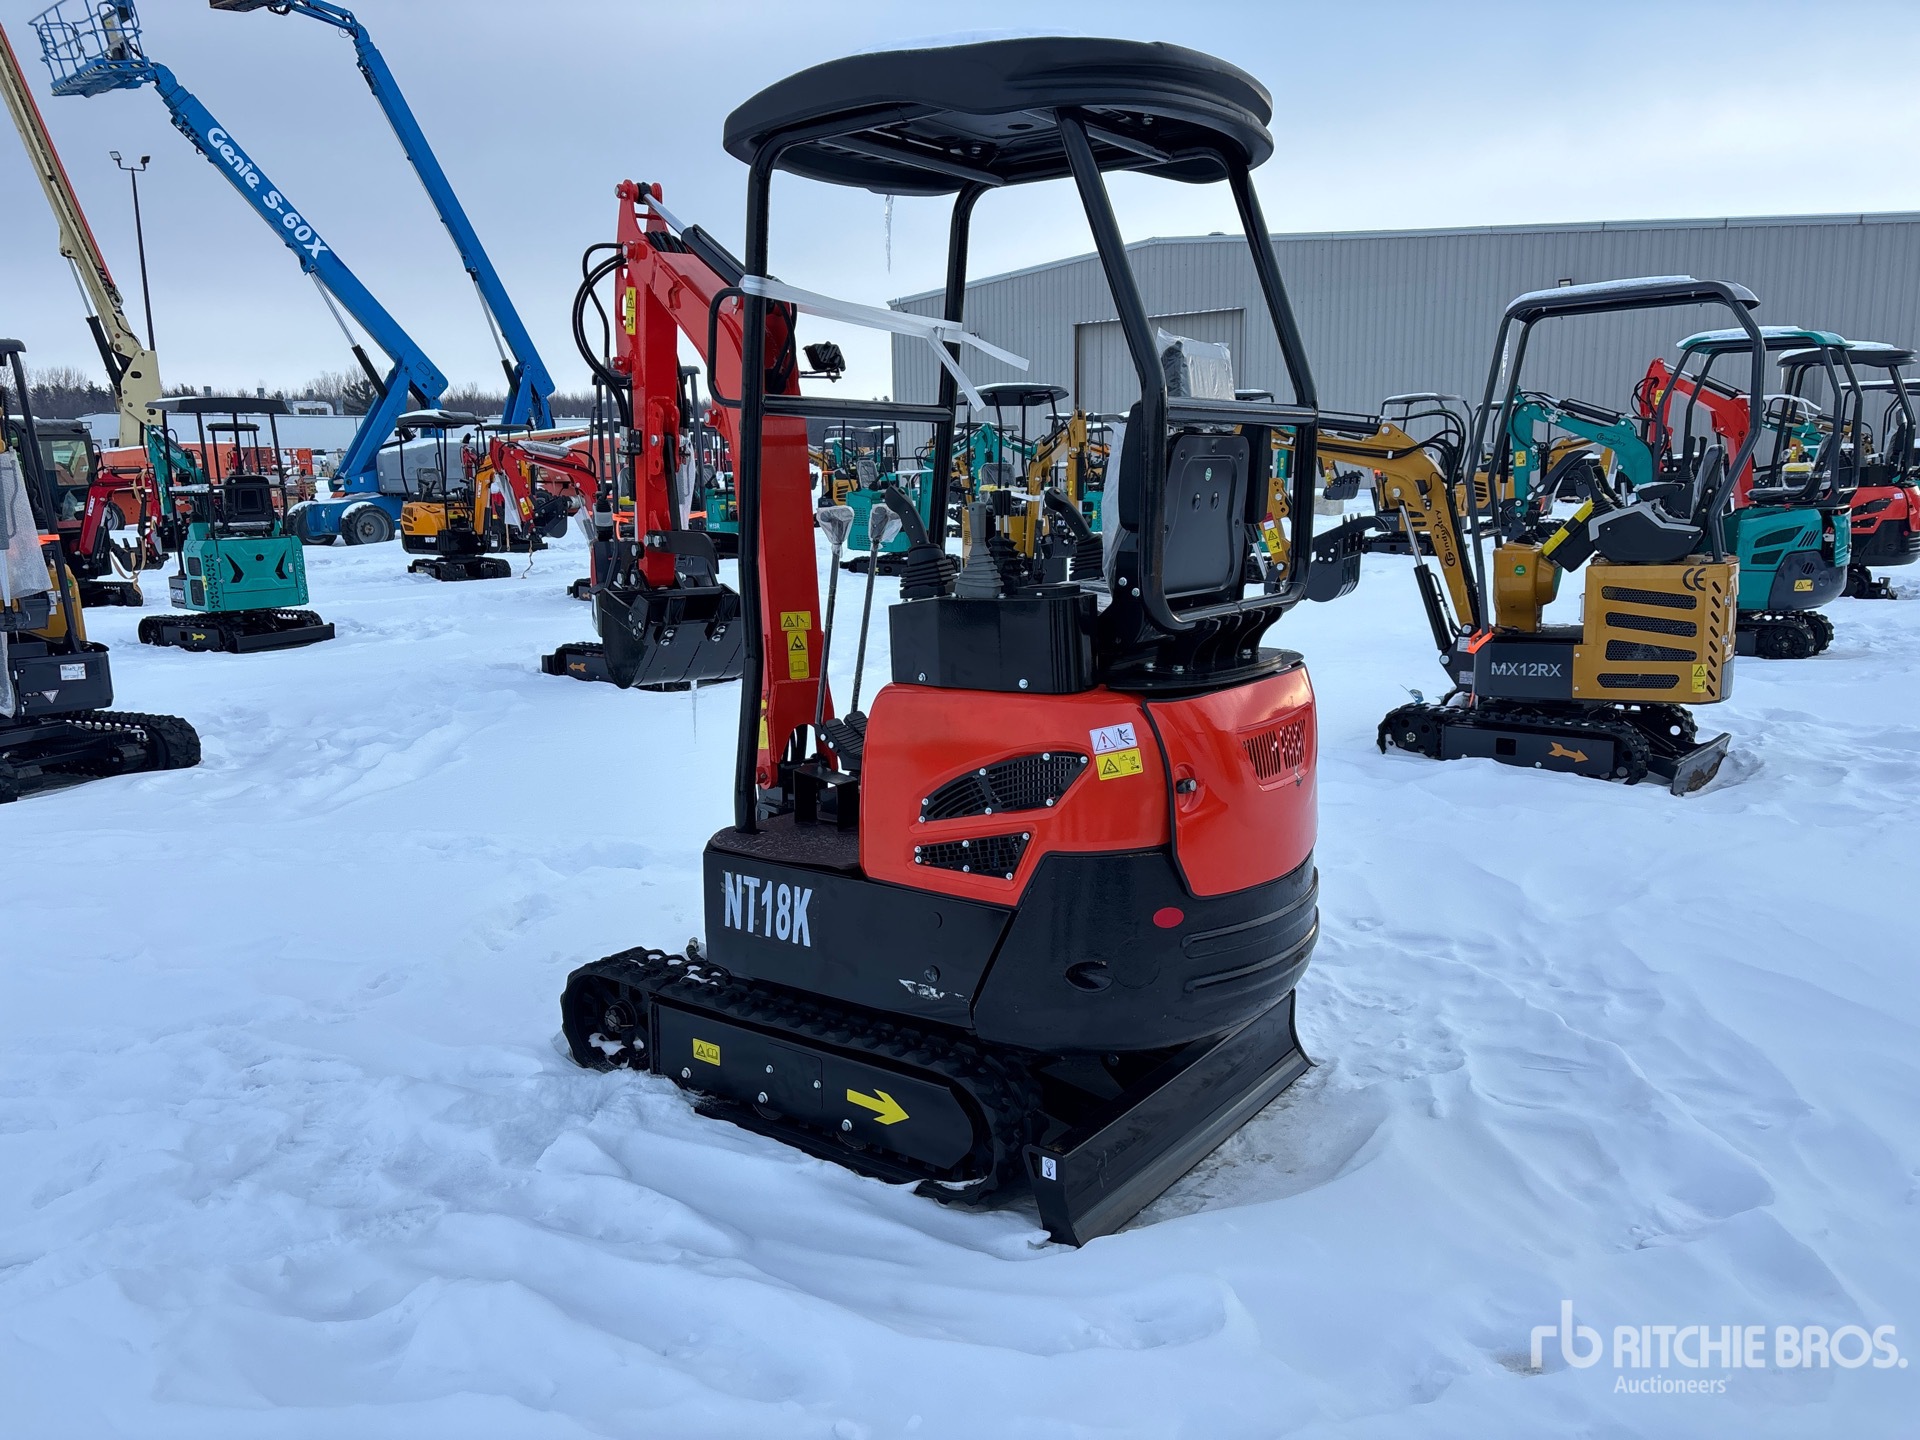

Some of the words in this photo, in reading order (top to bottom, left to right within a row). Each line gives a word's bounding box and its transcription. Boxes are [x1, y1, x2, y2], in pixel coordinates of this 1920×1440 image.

[207, 127, 260, 190] Genie
[262, 190, 328, 259] S-60X
[1682, 567, 1706, 591] CE
[1491, 661, 1562, 677] MX12RX
[724, 871, 813, 947] NT18K
